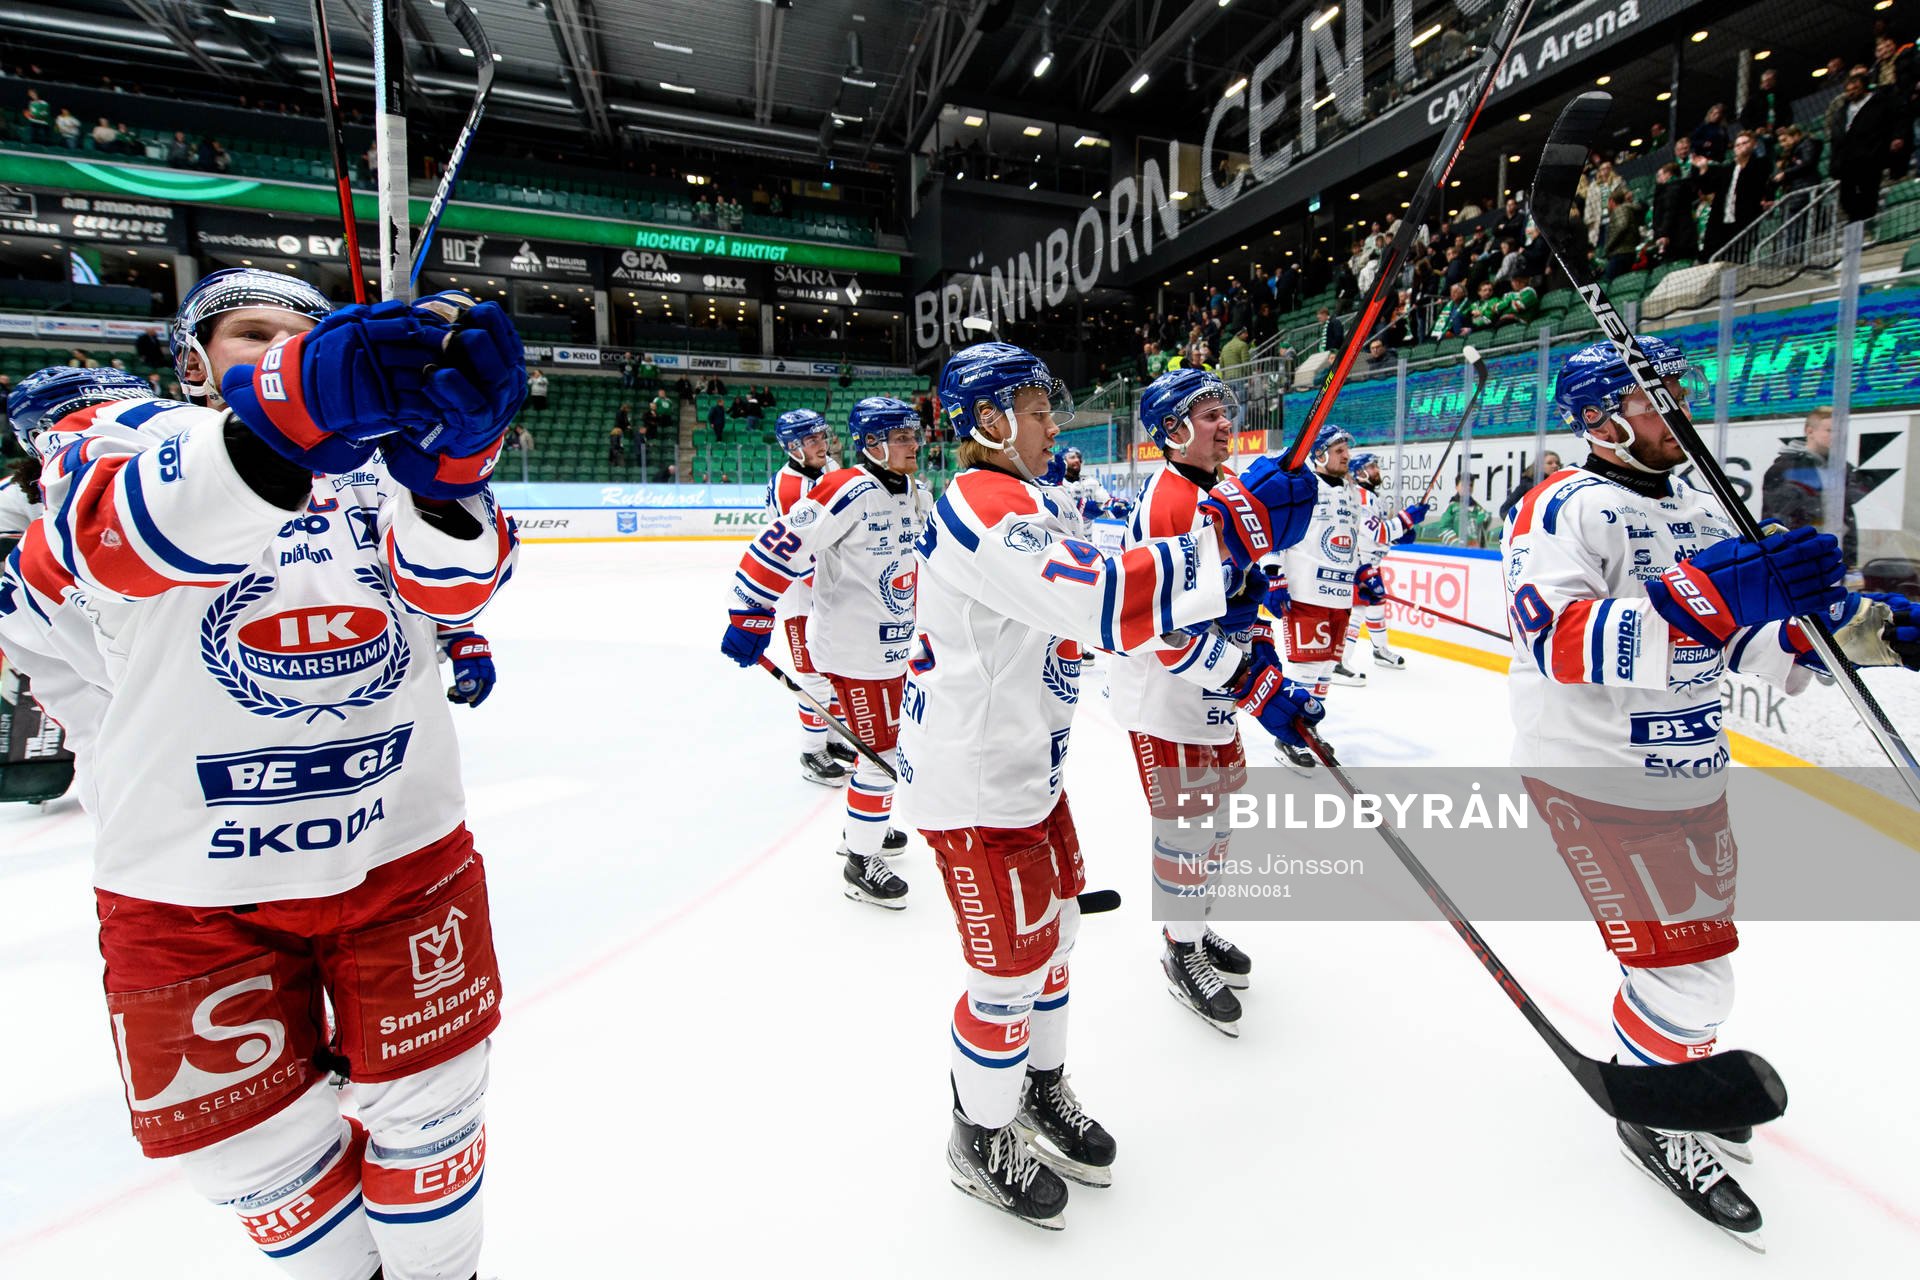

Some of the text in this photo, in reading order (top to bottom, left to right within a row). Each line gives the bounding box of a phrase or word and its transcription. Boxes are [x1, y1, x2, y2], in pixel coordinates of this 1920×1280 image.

[1537, 0, 1640, 70] Arena
[198, 231, 278, 249] Swedbank
[308, 235, 343, 257] EY
[621, 250, 668, 271] GPA
[636, 231, 788, 261] HOCKEY PÅ RIKTIGT
[915, 141, 1180, 350] BRÄNNBORN
[774, 264, 837, 287] SÄKRA
[796, 289, 823, 300] MIAS
[825, 291, 838, 301] AB
[1578, 282, 1680, 416] NEXUS
[600, 486, 706, 506] Rubinpool
[1660, 502, 1678, 510] SHL
[516, 519, 569, 529] AUER
[760, 521, 802, 562] 22
[1339, 537, 1350, 546] IK
[1041, 538, 1106, 586] 14
[1664, 564, 1718, 615] BAU
[279, 612, 360, 647] IK
[742, 618, 775, 629] BAU
[1295, 621, 1331, 649] LS
[244, 636, 388, 676] OSKARSHAMN
[789, 625, 803, 668] coolcon
[884, 648, 909, 663] ŠKO
[1616, 609, 1635, 680] compo
[1244, 670, 1278, 713] AUER
[1721, 679, 1788, 735] ank
[850, 687, 876, 746] coolcon
[228, 761, 297, 791] BE
[343, 737, 397, 779] GE
[208, 797, 385, 860] ŠKODA
[953, 866, 997, 968] coolcon
[1567, 845, 1638, 953] coolcon
[1016, 934, 1041, 949] LYFT
[1664, 922, 1711, 941] LYFT &
[380, 975, 491, 1036] Smålands-
[382, 990, 497, 1061] hamnar AB
[112, 974, 286, 1112] LS
[133, 1063, 296, 1130] LYFT & SERVICE
[443, 1171, 475, 1195] GROUP
[977, 1167, 1005, 1198] BAUER
[1650, 1154, 1682, 1190] BAUER
[260, 1230, 293, 1243] GROUP
